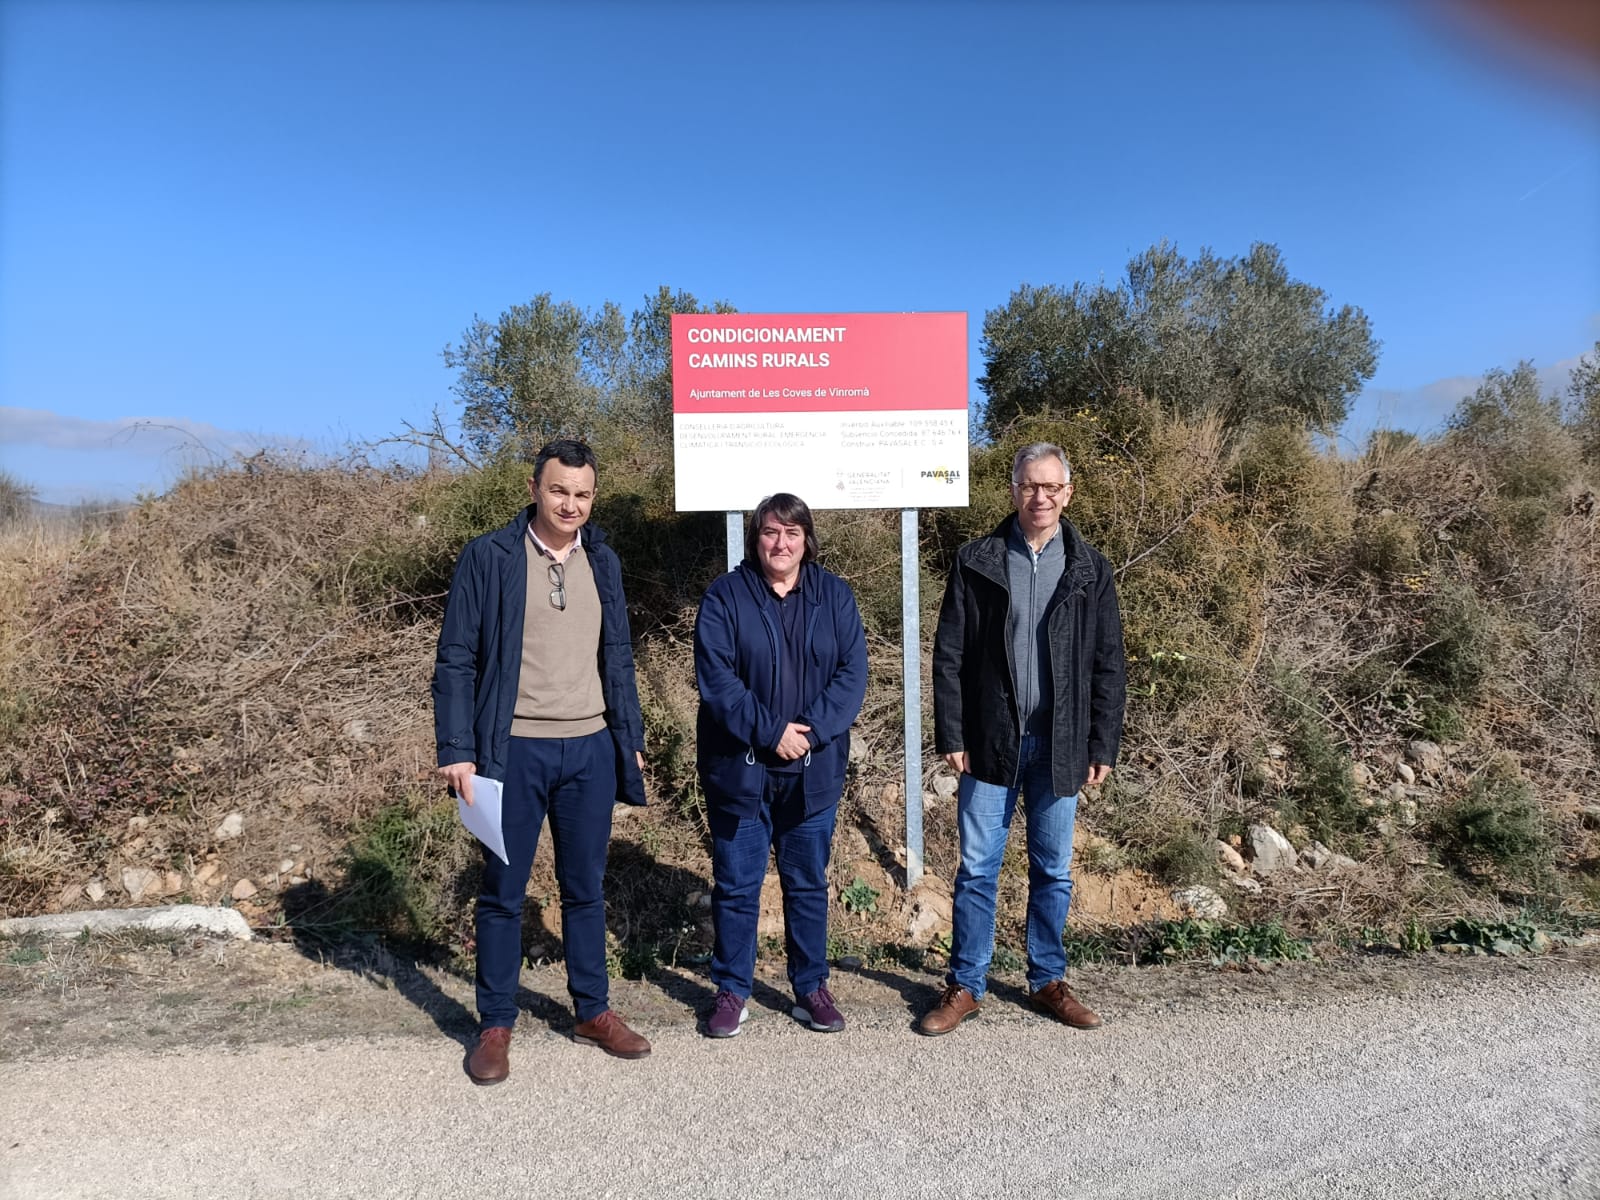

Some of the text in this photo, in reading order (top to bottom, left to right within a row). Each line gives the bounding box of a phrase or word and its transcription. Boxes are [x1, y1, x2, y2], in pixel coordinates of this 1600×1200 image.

[687, 327, 846, 343] CONDICIONAMENT
[688, 352, 830, 368] CAMINS RURALS
[689, 387, 870, 399] Ajuntament de Les Coves de Vinromà
[920, 470, 960, 478] PAVASAL
